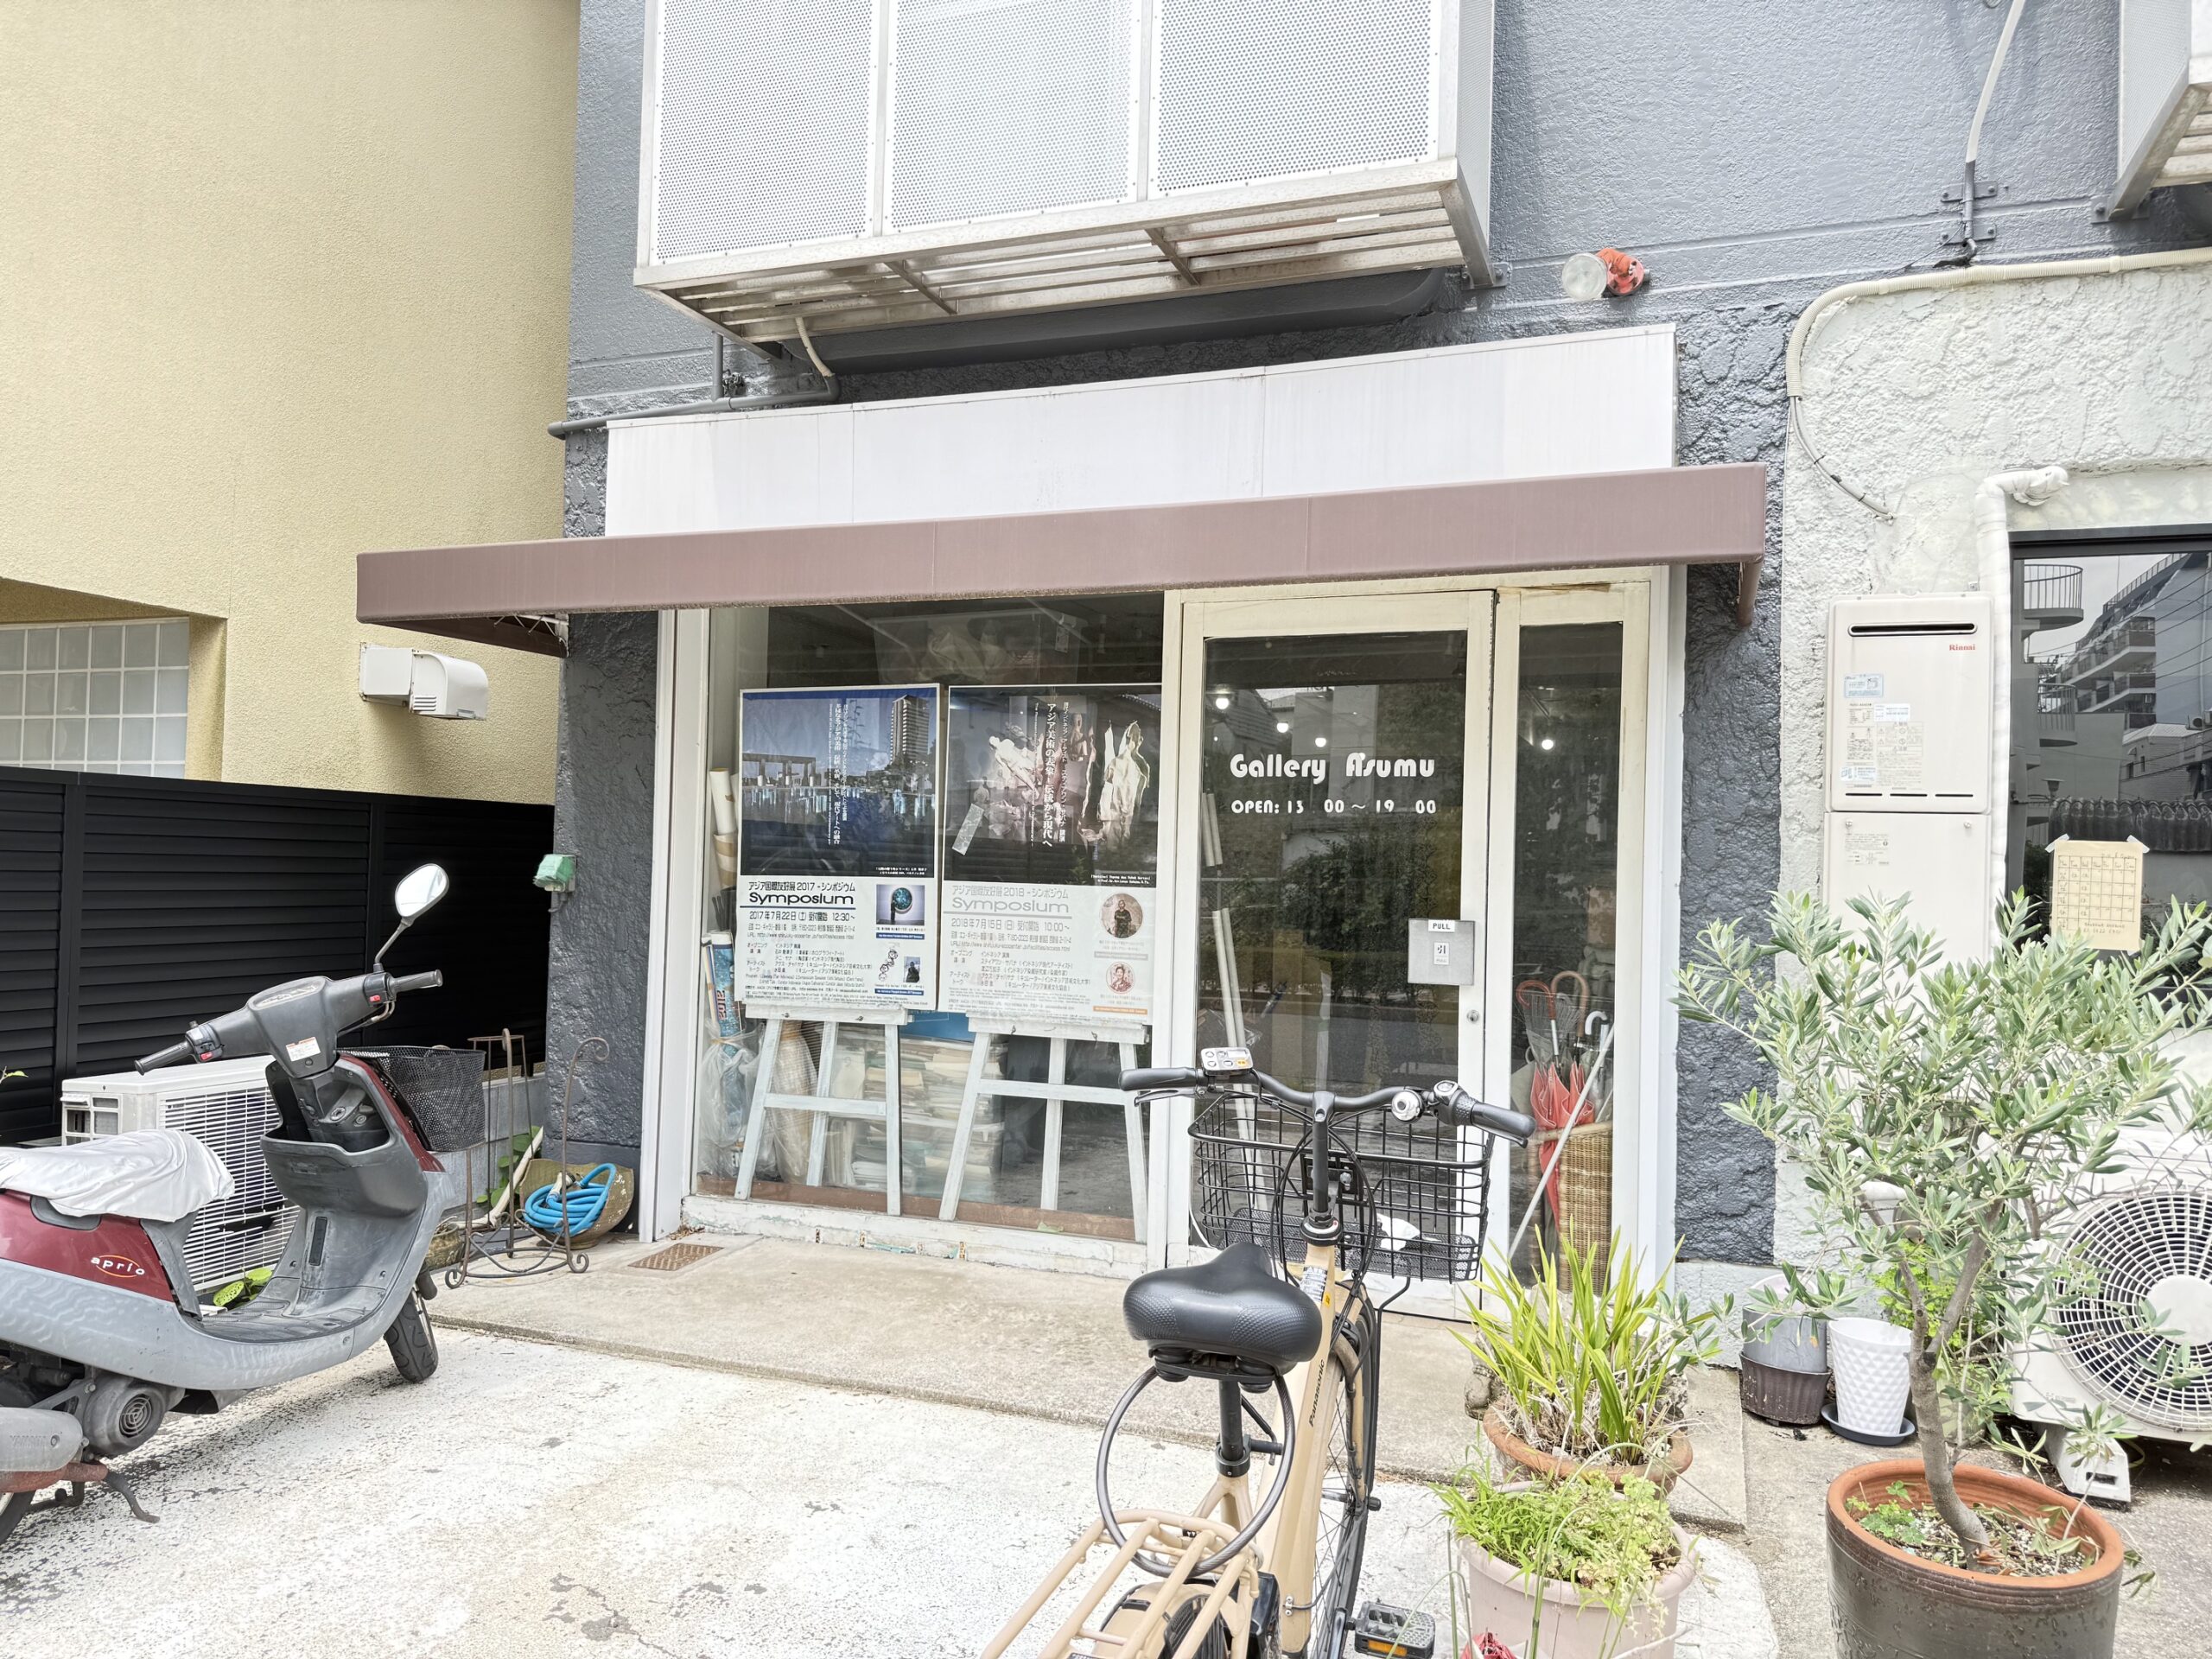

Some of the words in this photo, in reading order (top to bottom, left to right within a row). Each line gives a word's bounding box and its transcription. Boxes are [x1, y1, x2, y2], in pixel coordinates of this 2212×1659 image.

[1230, 753, 1326, 785] Gallery
[1345, 752, 1435, 778] Asumu
[1230, 799, 1280, 814] OPEN:
[1287, 800, 1304, 814] 13
[1324, 799, 1344, 813] 00
[1376, 799, 1395, 813] 19
[1415, 799, 1436, 814] 00
[748, 892, 854, 905] Symposium
[951, 897, 1069, 913] Symposium
[90, 1256, 145, 1275] aprio
[1308, 1358, 1325, 1428] Panasonic
